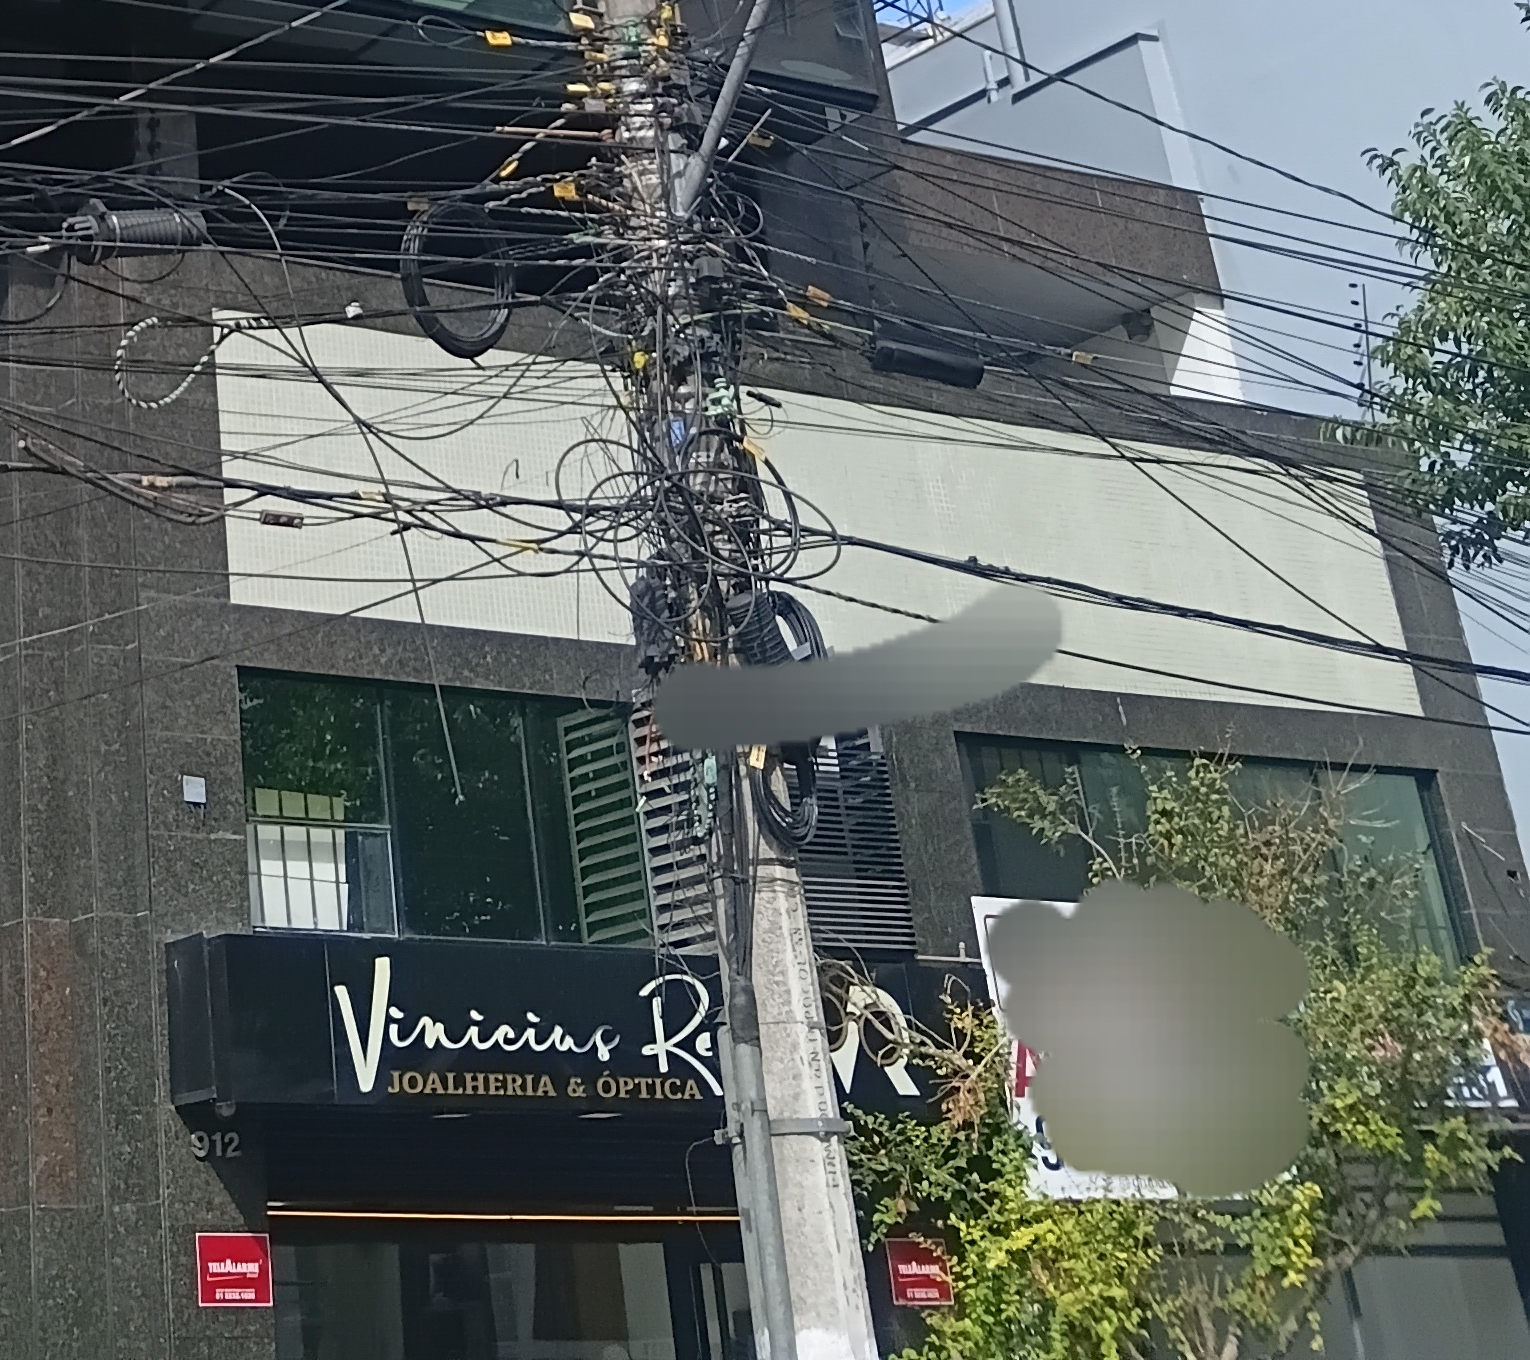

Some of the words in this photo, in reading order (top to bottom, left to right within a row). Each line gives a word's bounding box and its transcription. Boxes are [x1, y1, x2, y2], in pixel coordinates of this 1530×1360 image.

[334, 957, 621, 1093] Vinicius
[638, 973, 724, 1096] Re
[387, 1069, 556, 1098] JOALHERIA
[567, 1073, 587, 1097] &
[599, 1069, 704, 1101] ÓPTICA
[190, 1131, 243, 1158] 912
